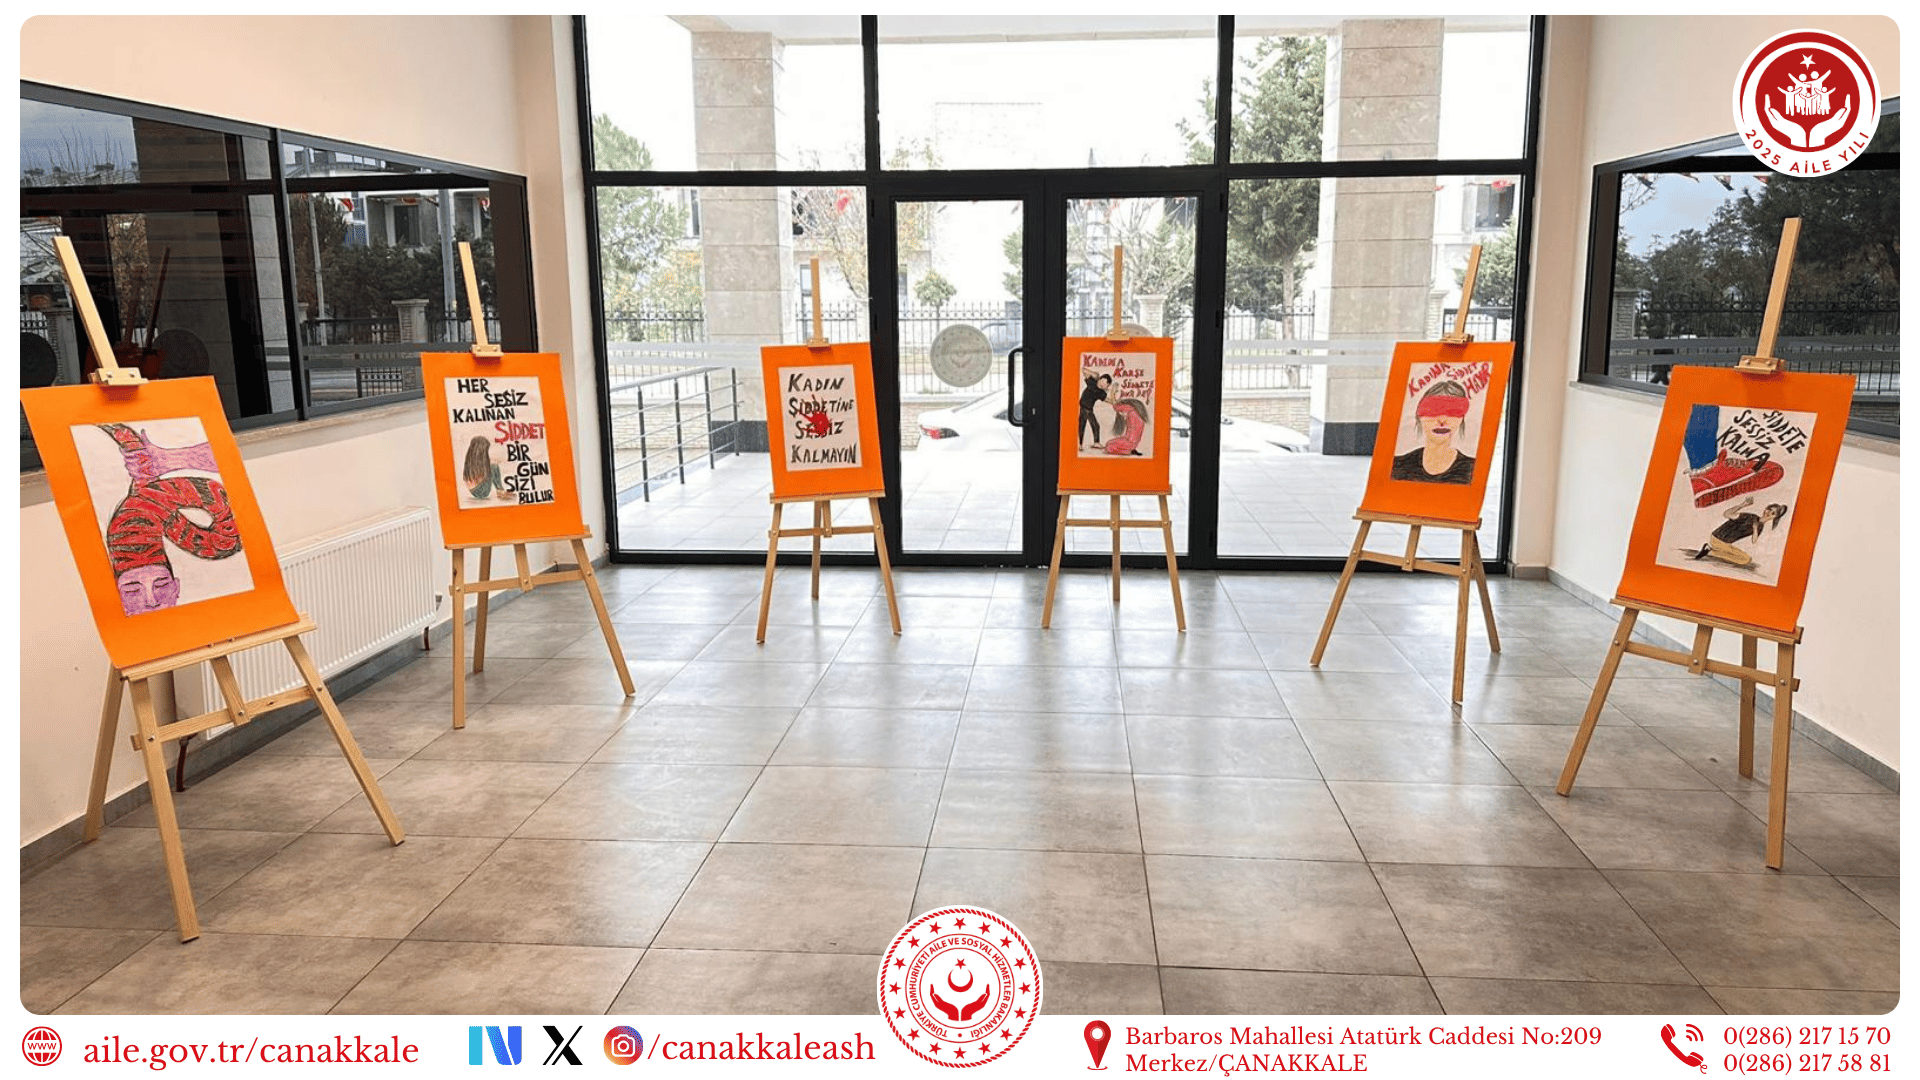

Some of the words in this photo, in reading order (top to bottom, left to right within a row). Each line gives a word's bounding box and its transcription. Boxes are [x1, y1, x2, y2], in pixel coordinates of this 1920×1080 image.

[457, 379, 490, 393] HER
[788, 373, 844, 392] KADIN
[453, 408, 515, 423] KALINAN
[494, 421, 545, 445] ŞİDDET
[1733, 409, 1776, 450] SESSİZ
[1762, 410, 1807, 454] ŞİDDETE
[506, 440, 532, 462] BİR
[791, 442, 857, 464] KALMAYIN
[1716, 425, 1770, 473] KALMA
[516, 462, 549, 477] GÜN
[518, 489, 555, 505] BULUR
